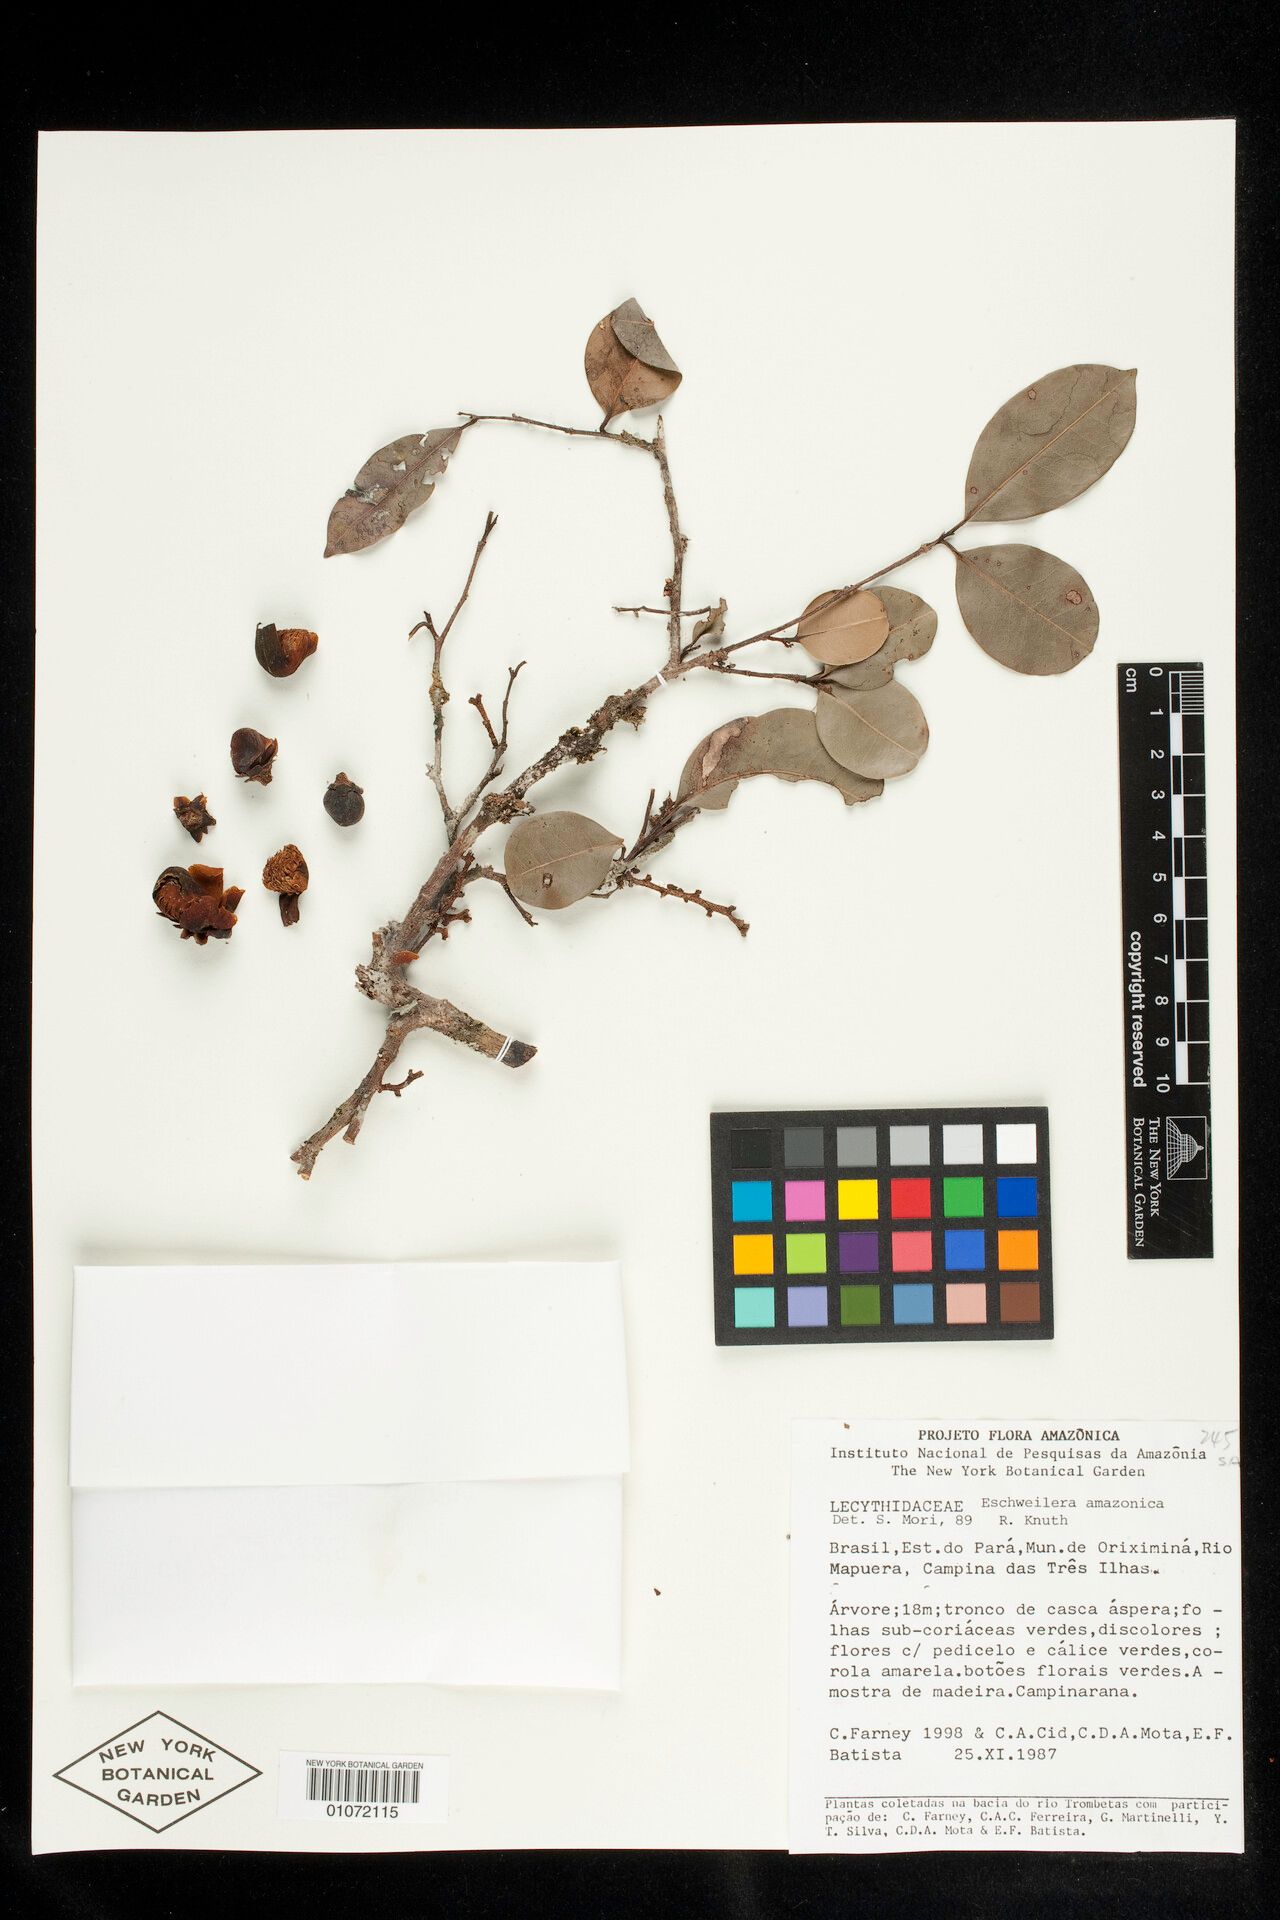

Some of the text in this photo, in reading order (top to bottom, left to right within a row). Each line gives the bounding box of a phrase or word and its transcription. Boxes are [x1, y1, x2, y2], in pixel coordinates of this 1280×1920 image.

[1148, 666, 1164, 677] 0
[1125, 667, 1137, 693] cm
[1149, 708, 1164, 716] 1
[1150, 749, 1165, 760] 2
[1150, 789, 1166, 800] 3
[1151, 830, 1167, 841] 4
[1152, 872, 1167, 883] 5
[1153, 912, 1168, 924] 6
[1153, 954, 1169, 965] 7
[1154, 995, 1170, 1006] 8
[1128, 931, 1147, 1087] copyright reserved
[1155, 1036, 1170, 1047] 9
[1156, 1073, 1171, 1094] 10
[1148, 1116, 1162, 1217] THE NEW YORK
[1132, 1117, 1146, 1247] BOTANICAL GARDEN
[918, 1429, 980, 1441] PROJETO
[988, 1429, 1033, 1442] FLORA
[830, 1446, 909, 1459] Instituto
[917, 1446, 987, 1459] Nacional
[996, 1447, 1014, 1459] de
[1023, 1447, 1102, 1463] Pesquisas
[1110, 1447, 1128, 1460] da
[891, 1464, 1146, 1477] The New York Botanical Garden
[829, 1499, 964, 1513] LECYTHIDACEAE
[981, 1496, 1165, 1509] Eschweilera amazonica
[832, 1513, 973, 1527] Det. S. Mori, 89
[999, 1514, 1068, 1526] R. Knuth
[829, 1536, 1233, 1557] Brasil,Est.do Pará,Mun.de Oriximiná,Rio
[829, 1562, 909, 1578] Mapuera,
[922, 1562, 996, 1578] Campina
[1005, 1561, 1036, 1575] das
[1046, 1557, 1088, 1574] Três
[829, 1599, 1005, 1619] Árvore;18m;tronco
[1016, 1603, 1036, 1616] de
[1047, 1605, 1099, 1616] casca
[1108, 1598, 1202, 1618] áspera;fo
[829, 1623, 870, 1637] lhas
[881, 1619, 1015, 1637] sub-coriáceas
[1026, 1624, 1201, 1639] verdes,discolores
[830, 1639, 1223, 1660] flores c/ pedicelo e cálice verdes,co-
[829, 1664, 871, 1678] rola
[881, 1660, 1026, 1678] amarela.botões
[1037, 1664, 1108, 1677] florais
[1119, 1664, 1203, 1678] verdes.A
[828, 1684, 1138, 1701] mostra de madeira.Campinarana.
[829, 1726, 1233, 1743] C.Farney 1998 & C.A.Cid,C.D.A.Mota,E.F.
[99, 1738, 216, 1763] NEW YORK
[829, 1747, 1057, 1762] Batista 25.XI.1987
[305, 1759, 424, 1770] NEW YORK BOTANICAL GARDEN
[101, 1767, 215, 1782] BOTANICAL
[117, 1788, 201, 1807] GARDEN
[825, 1798, 1229, 1811] Plantas coletadas na bacia do rio Trombetas com partici-
[326, 1803, 399, 1819] 01072115
[826, 1811, 1228, 1825] pação de: C. Farney, C.A.C. Ferreira, G. Martinelli, Y.
[824, 1824, 1086, 1838] T. Silva, C.D.A. Mota & E.F. Batista.
